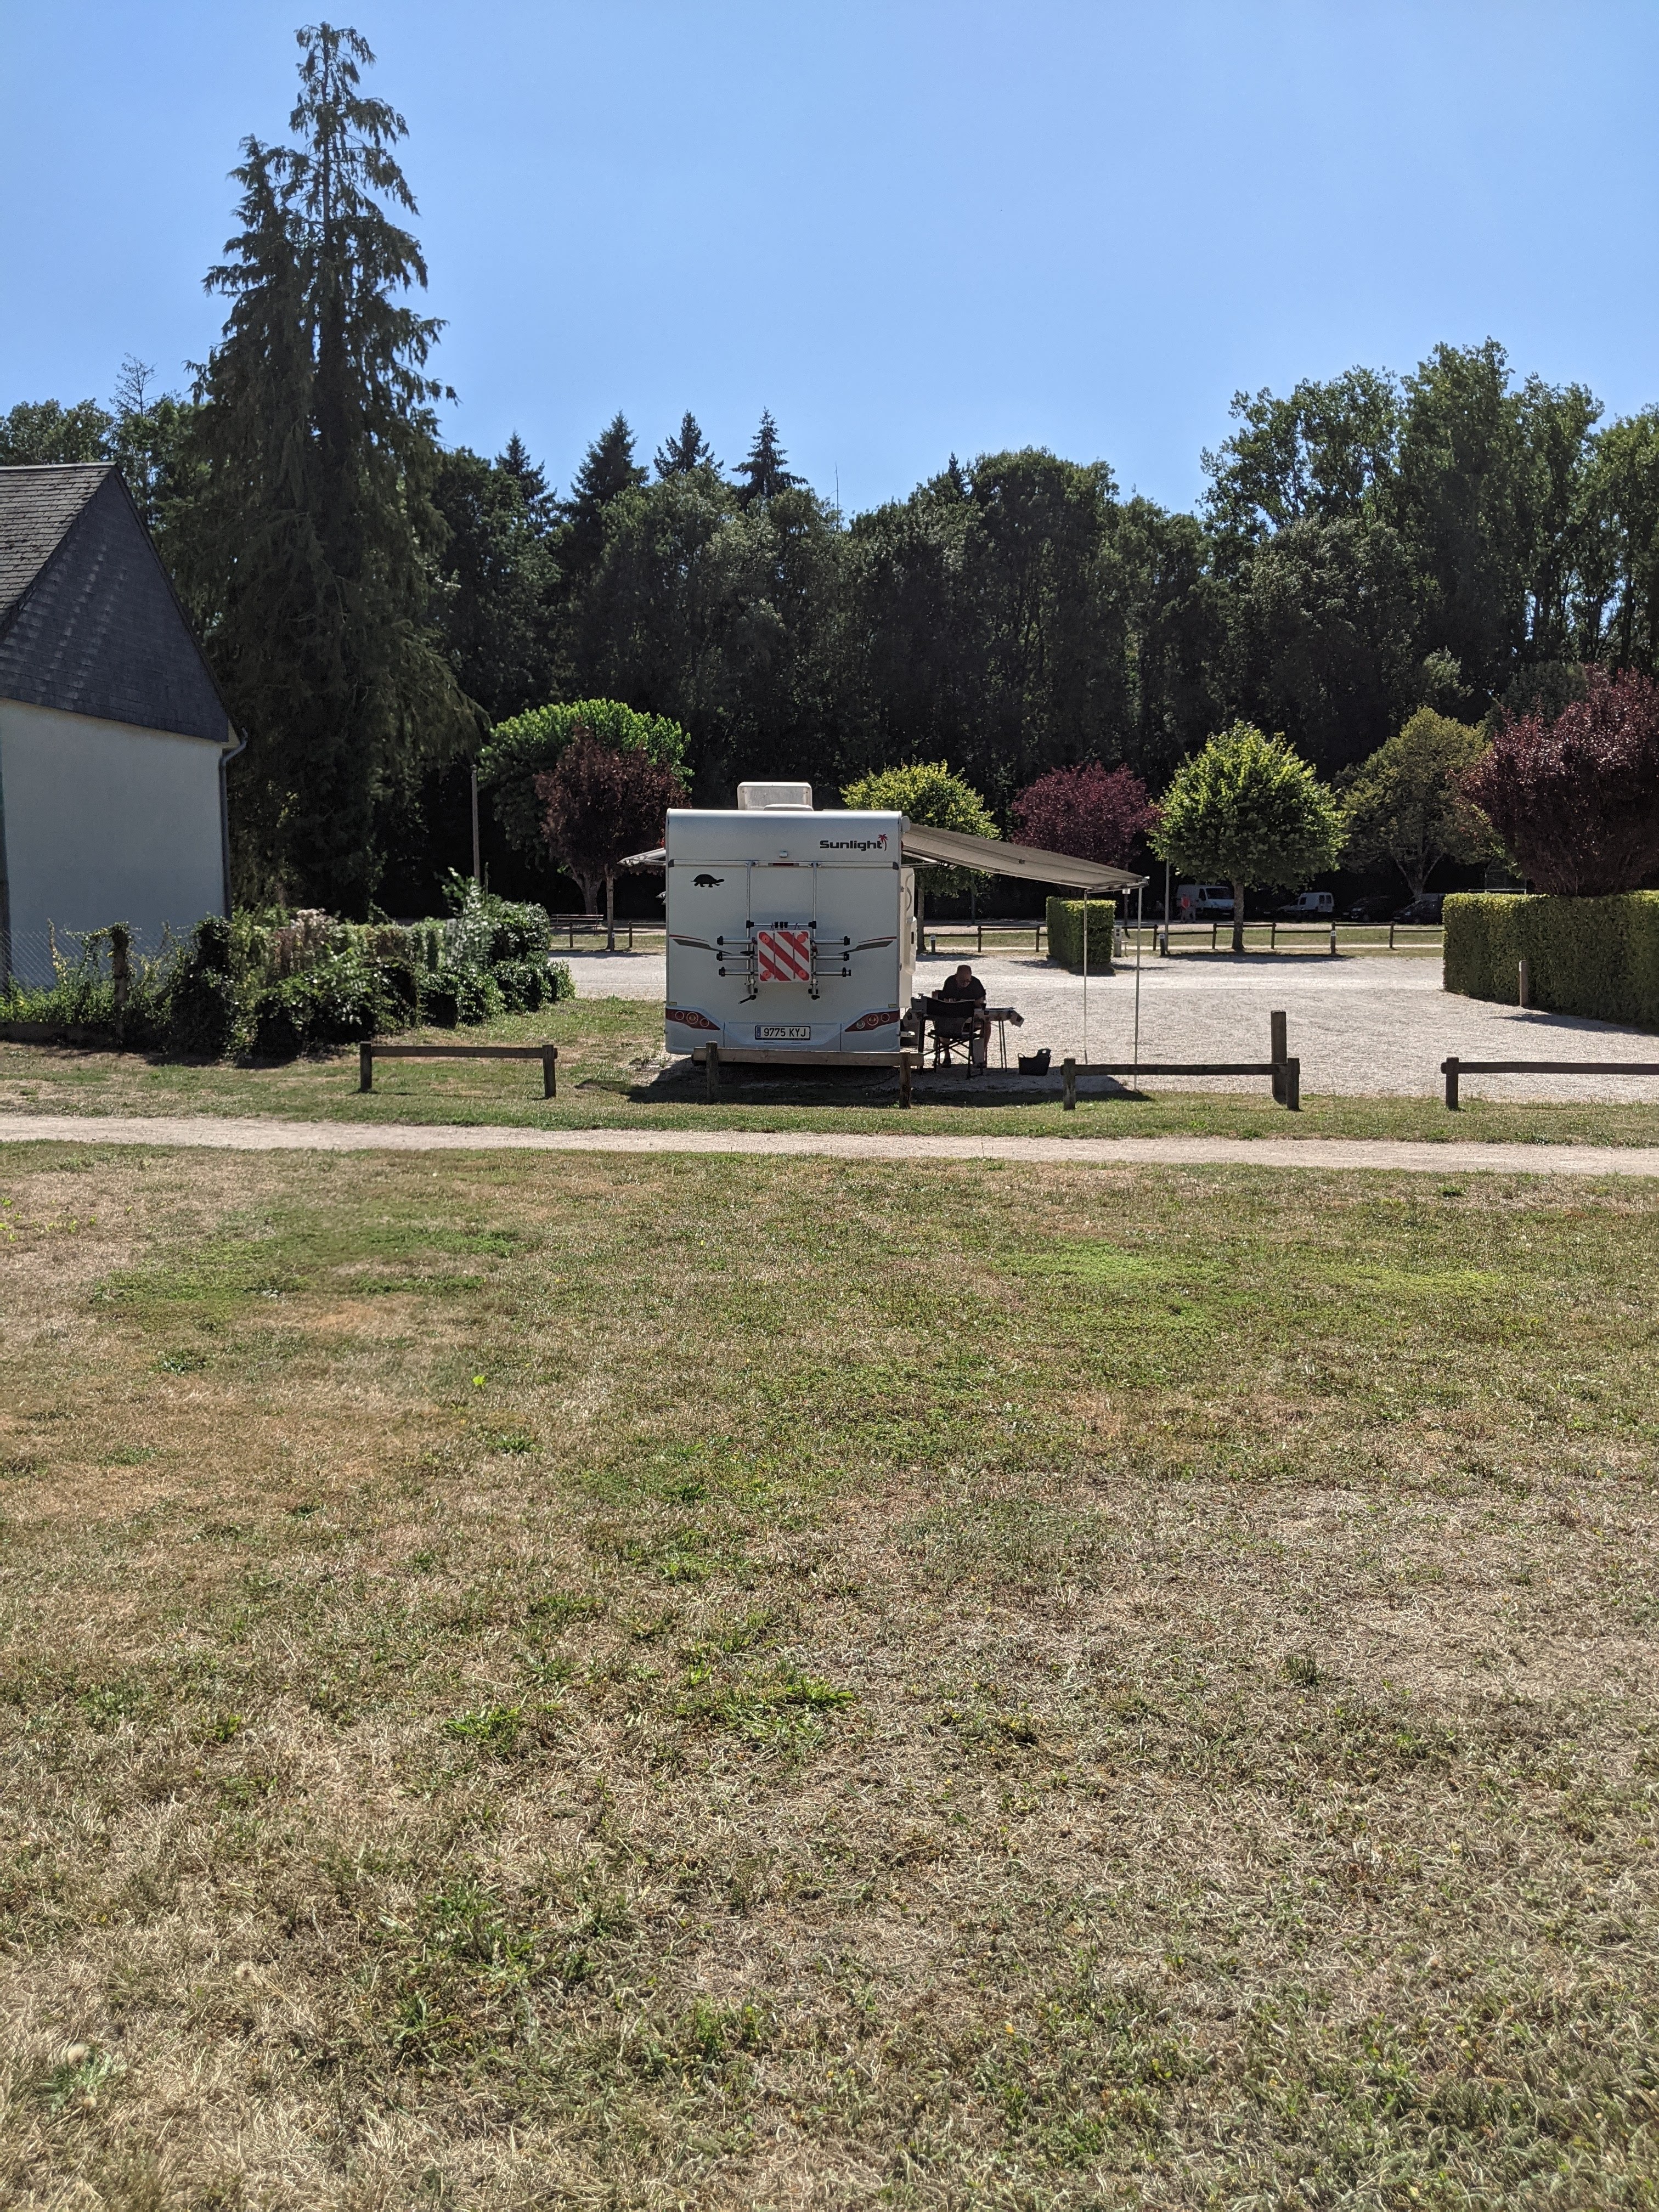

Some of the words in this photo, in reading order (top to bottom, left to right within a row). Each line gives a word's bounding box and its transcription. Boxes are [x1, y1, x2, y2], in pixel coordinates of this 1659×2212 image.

[820, 840, 882, 851] Sunlight
[764, 1028, 786, 1037] 9775
[789, 1028, 806, 1037] KYJ
